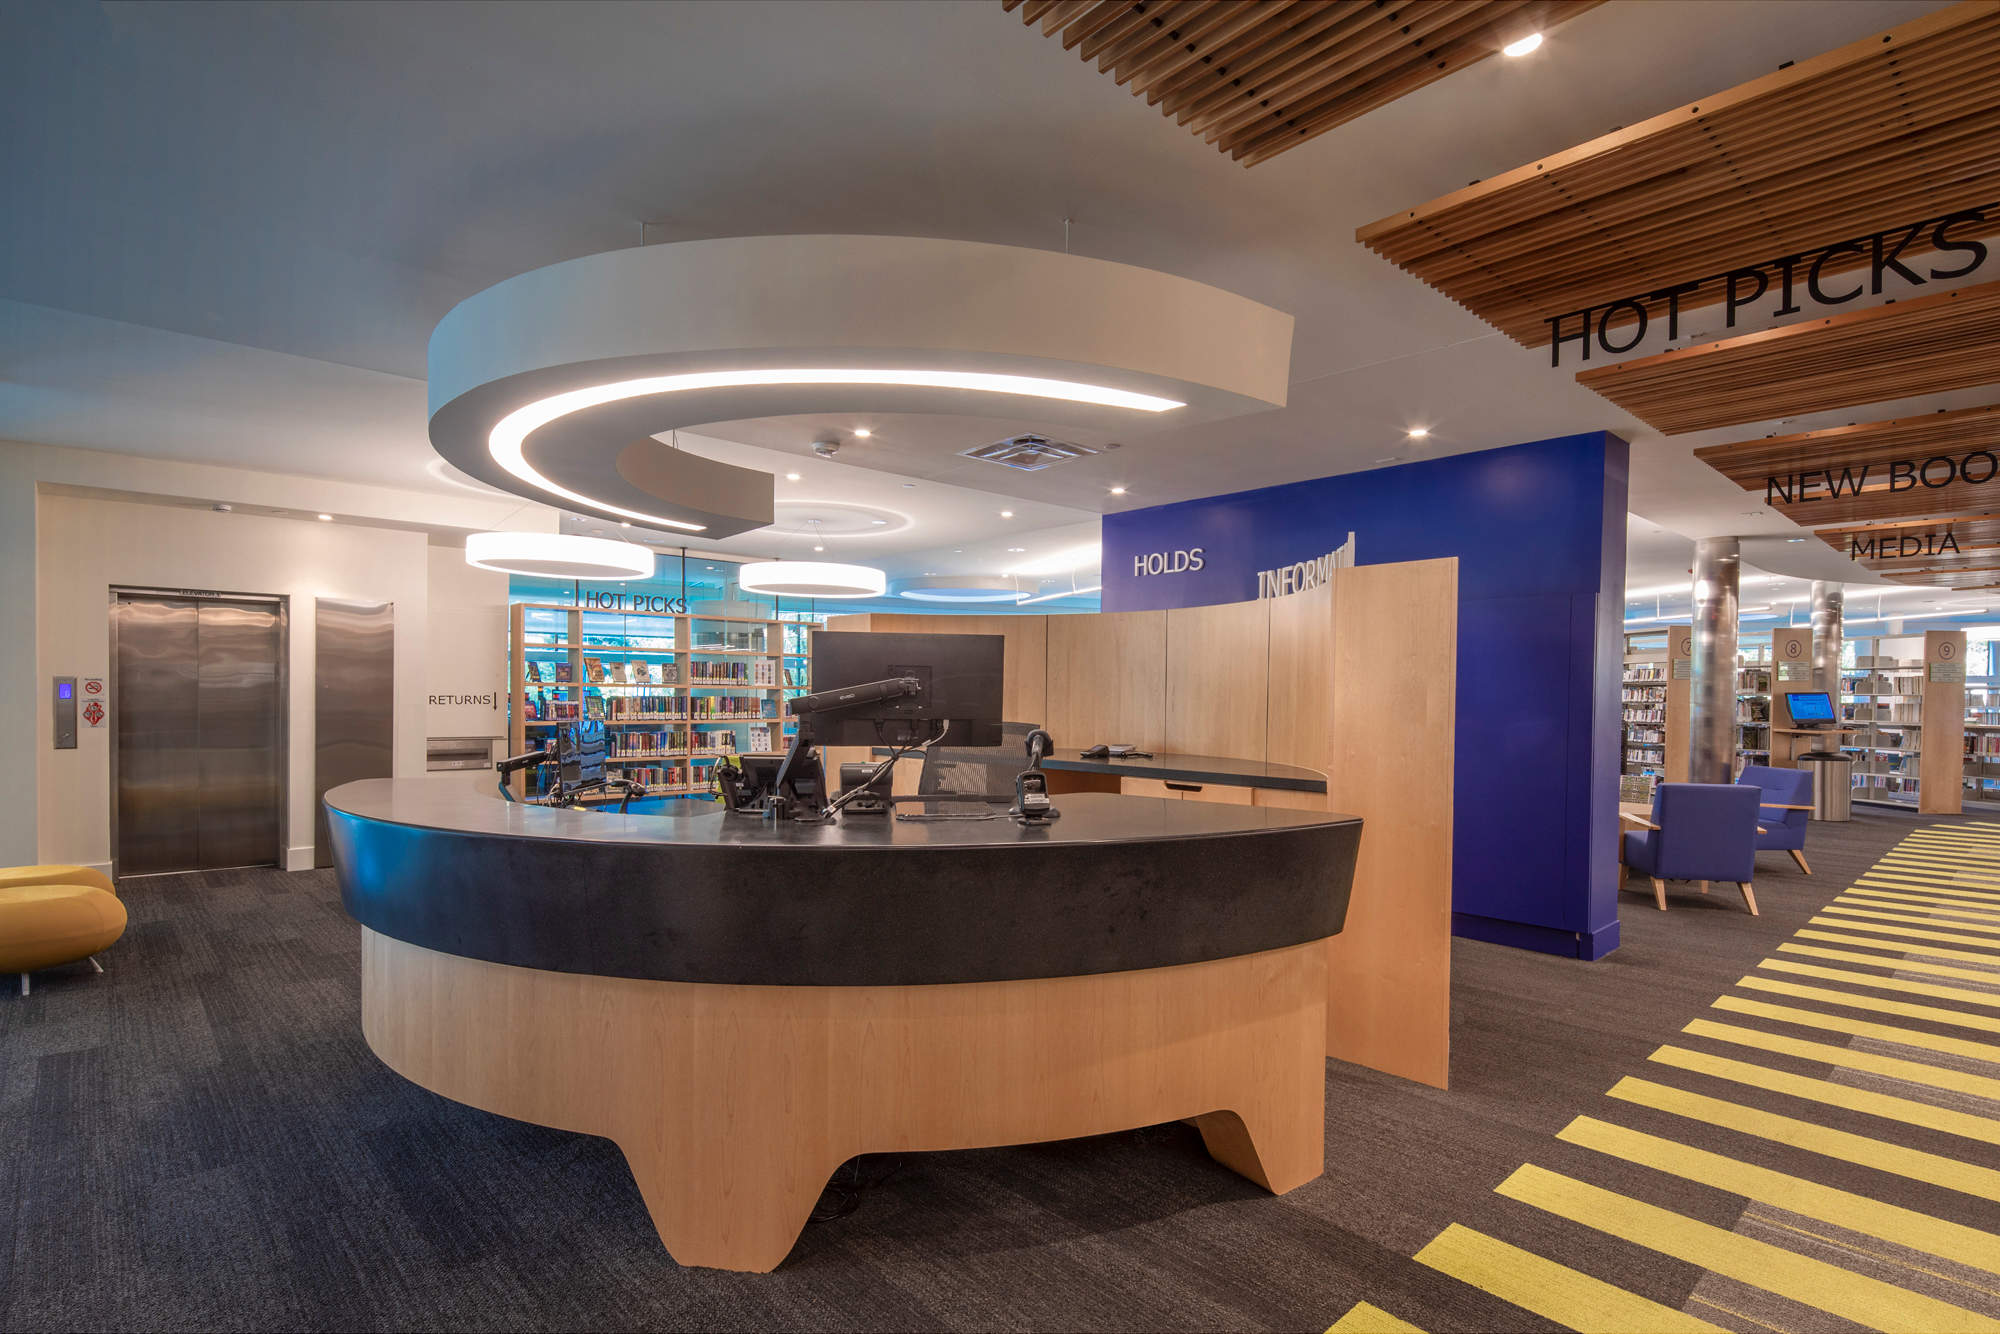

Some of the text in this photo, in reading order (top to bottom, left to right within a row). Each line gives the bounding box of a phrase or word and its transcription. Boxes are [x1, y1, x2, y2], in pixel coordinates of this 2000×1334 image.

[1547, 211, 1989, 368] HOT PICKS
[1766, 465, 1869, 505] NEW
[1851, 532, 1961, 561] MEDIA
[1134, 548, 1205, 577] HOLDS
[586, 591, 687, 614] HOT PICKS
[428, 694, 491, 705] RETURNS
